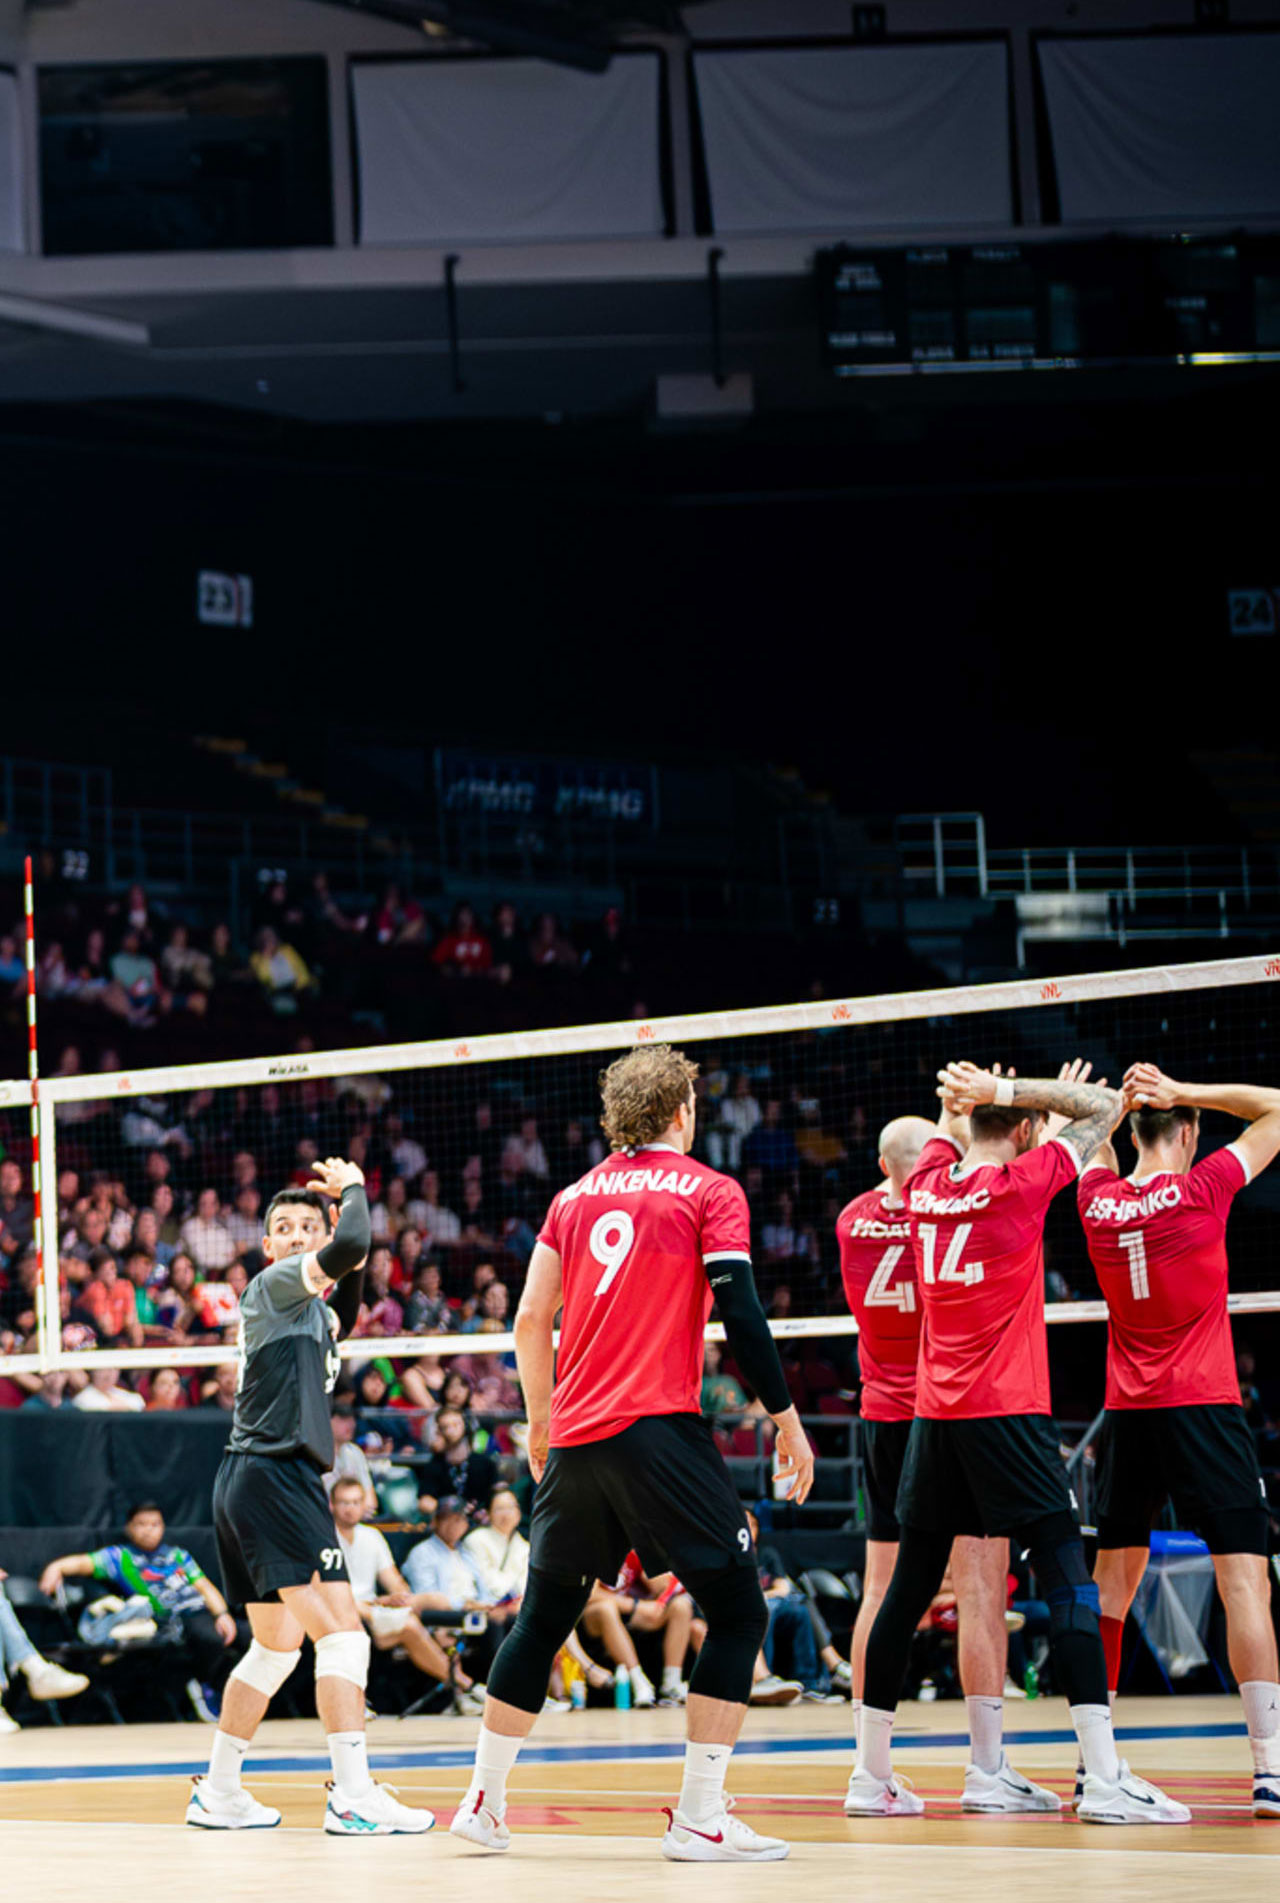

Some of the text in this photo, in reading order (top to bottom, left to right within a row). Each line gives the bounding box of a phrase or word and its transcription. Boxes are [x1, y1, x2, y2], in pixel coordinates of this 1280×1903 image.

[589, 1209, 636, 1297] 9
[863, 1245, 917, 1313] 4
[917, 1222, 985, 1288] 14
[1118, 1230, 1150, 1301] 1
[320, 1548, 343, 1570] 97
[736, 1528, 751, 1552] 9
